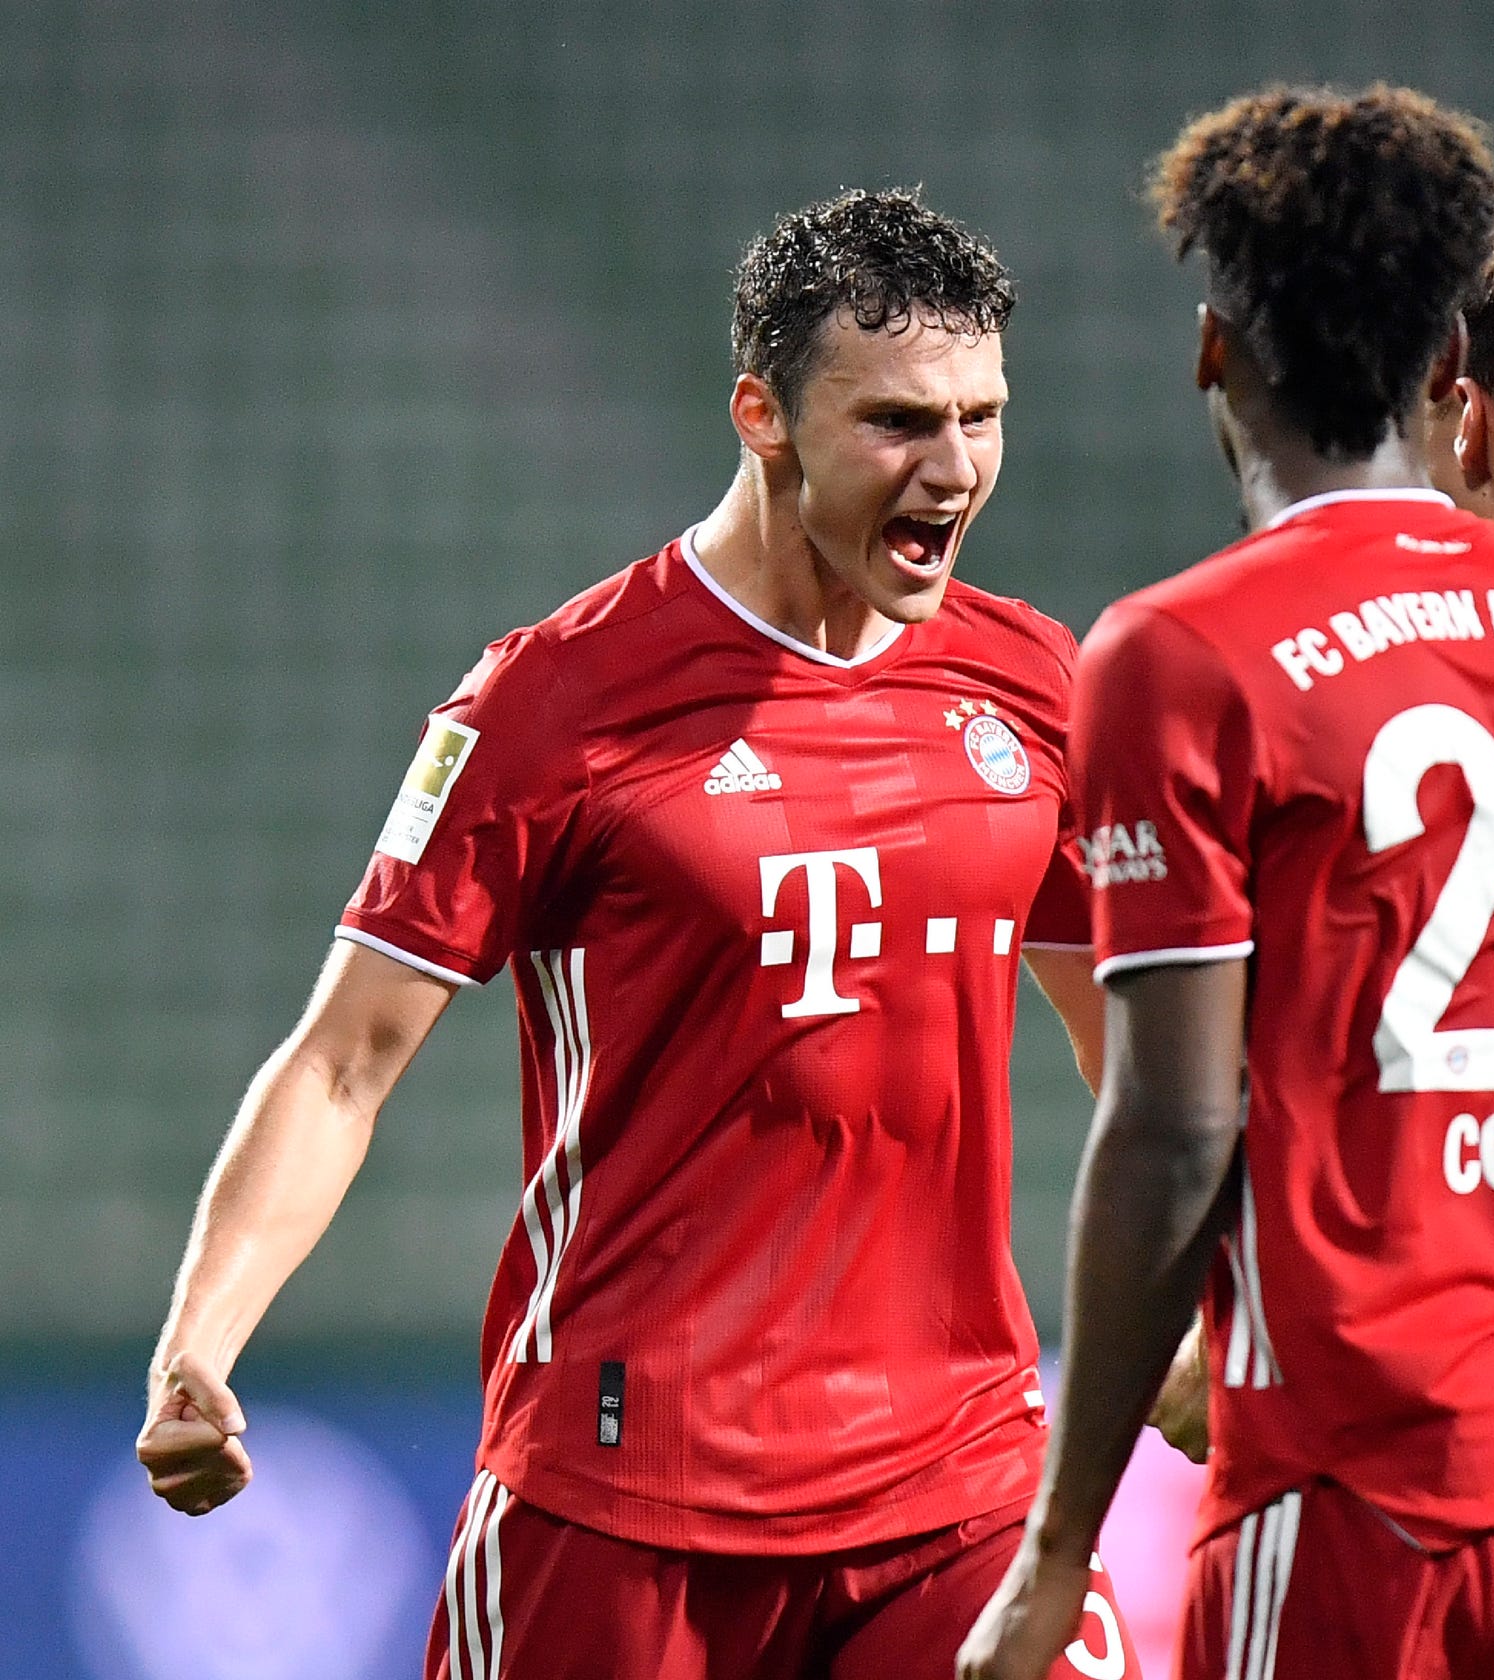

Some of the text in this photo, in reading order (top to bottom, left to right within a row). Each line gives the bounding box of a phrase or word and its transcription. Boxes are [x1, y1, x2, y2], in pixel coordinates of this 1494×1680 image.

[1270, 627, 1345, 692] FC
[1328, 588, 1487, 663] BAYERN
[703, 773, 783, 796] adidas
